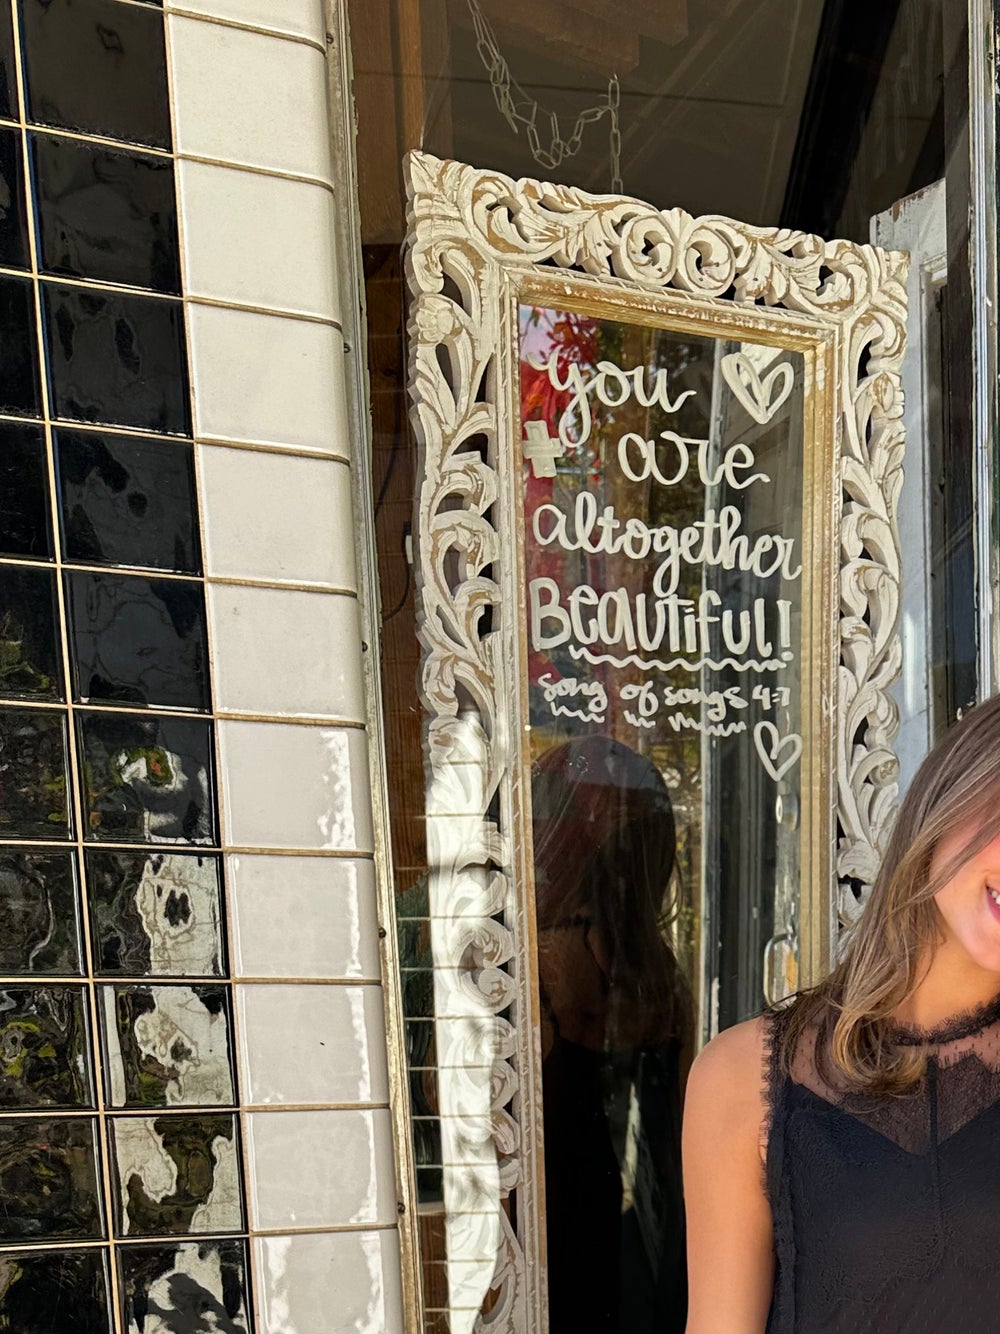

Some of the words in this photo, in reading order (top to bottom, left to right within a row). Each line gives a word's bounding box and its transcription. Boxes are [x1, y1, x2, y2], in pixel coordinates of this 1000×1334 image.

[526, 352, 697, 448] you
[617, 431, 771, 489] are
[532, 491, 802, 598] altogether
[620, 681, 659, 716] of
[752, 685, 791, 710] 4:7
